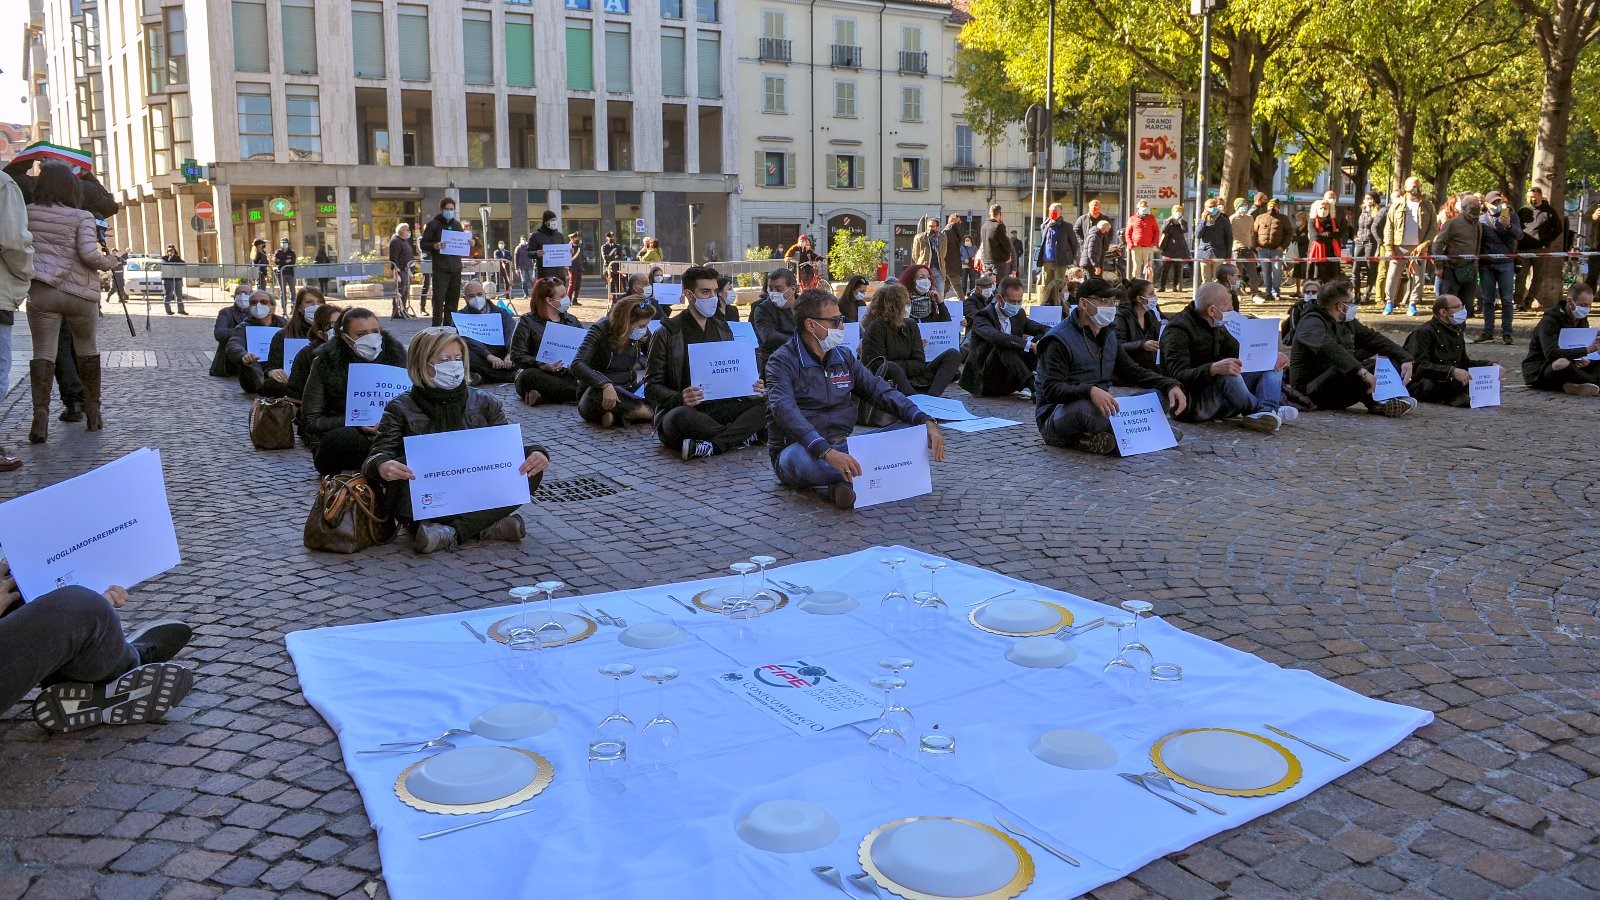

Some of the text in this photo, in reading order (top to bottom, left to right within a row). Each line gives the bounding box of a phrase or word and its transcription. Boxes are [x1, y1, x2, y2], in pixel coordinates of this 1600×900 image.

[709, 358, 740, 367] 1.200.000
[711, 367, 739, 375] ADDETTI
[1127, 417, 1148, 425] RISCHIO
[1125, 425, 1152, 435] CHIUSURA
[423, 461, 513, 479] #FIPECONFCOMMERCIO
[46, 518, 138, 565] #VOGLIAMOFAREIMPRESA
[760, 664, 814, 688] FIPE
[743, 681, 825, 732] CONFCOMMERCIO
